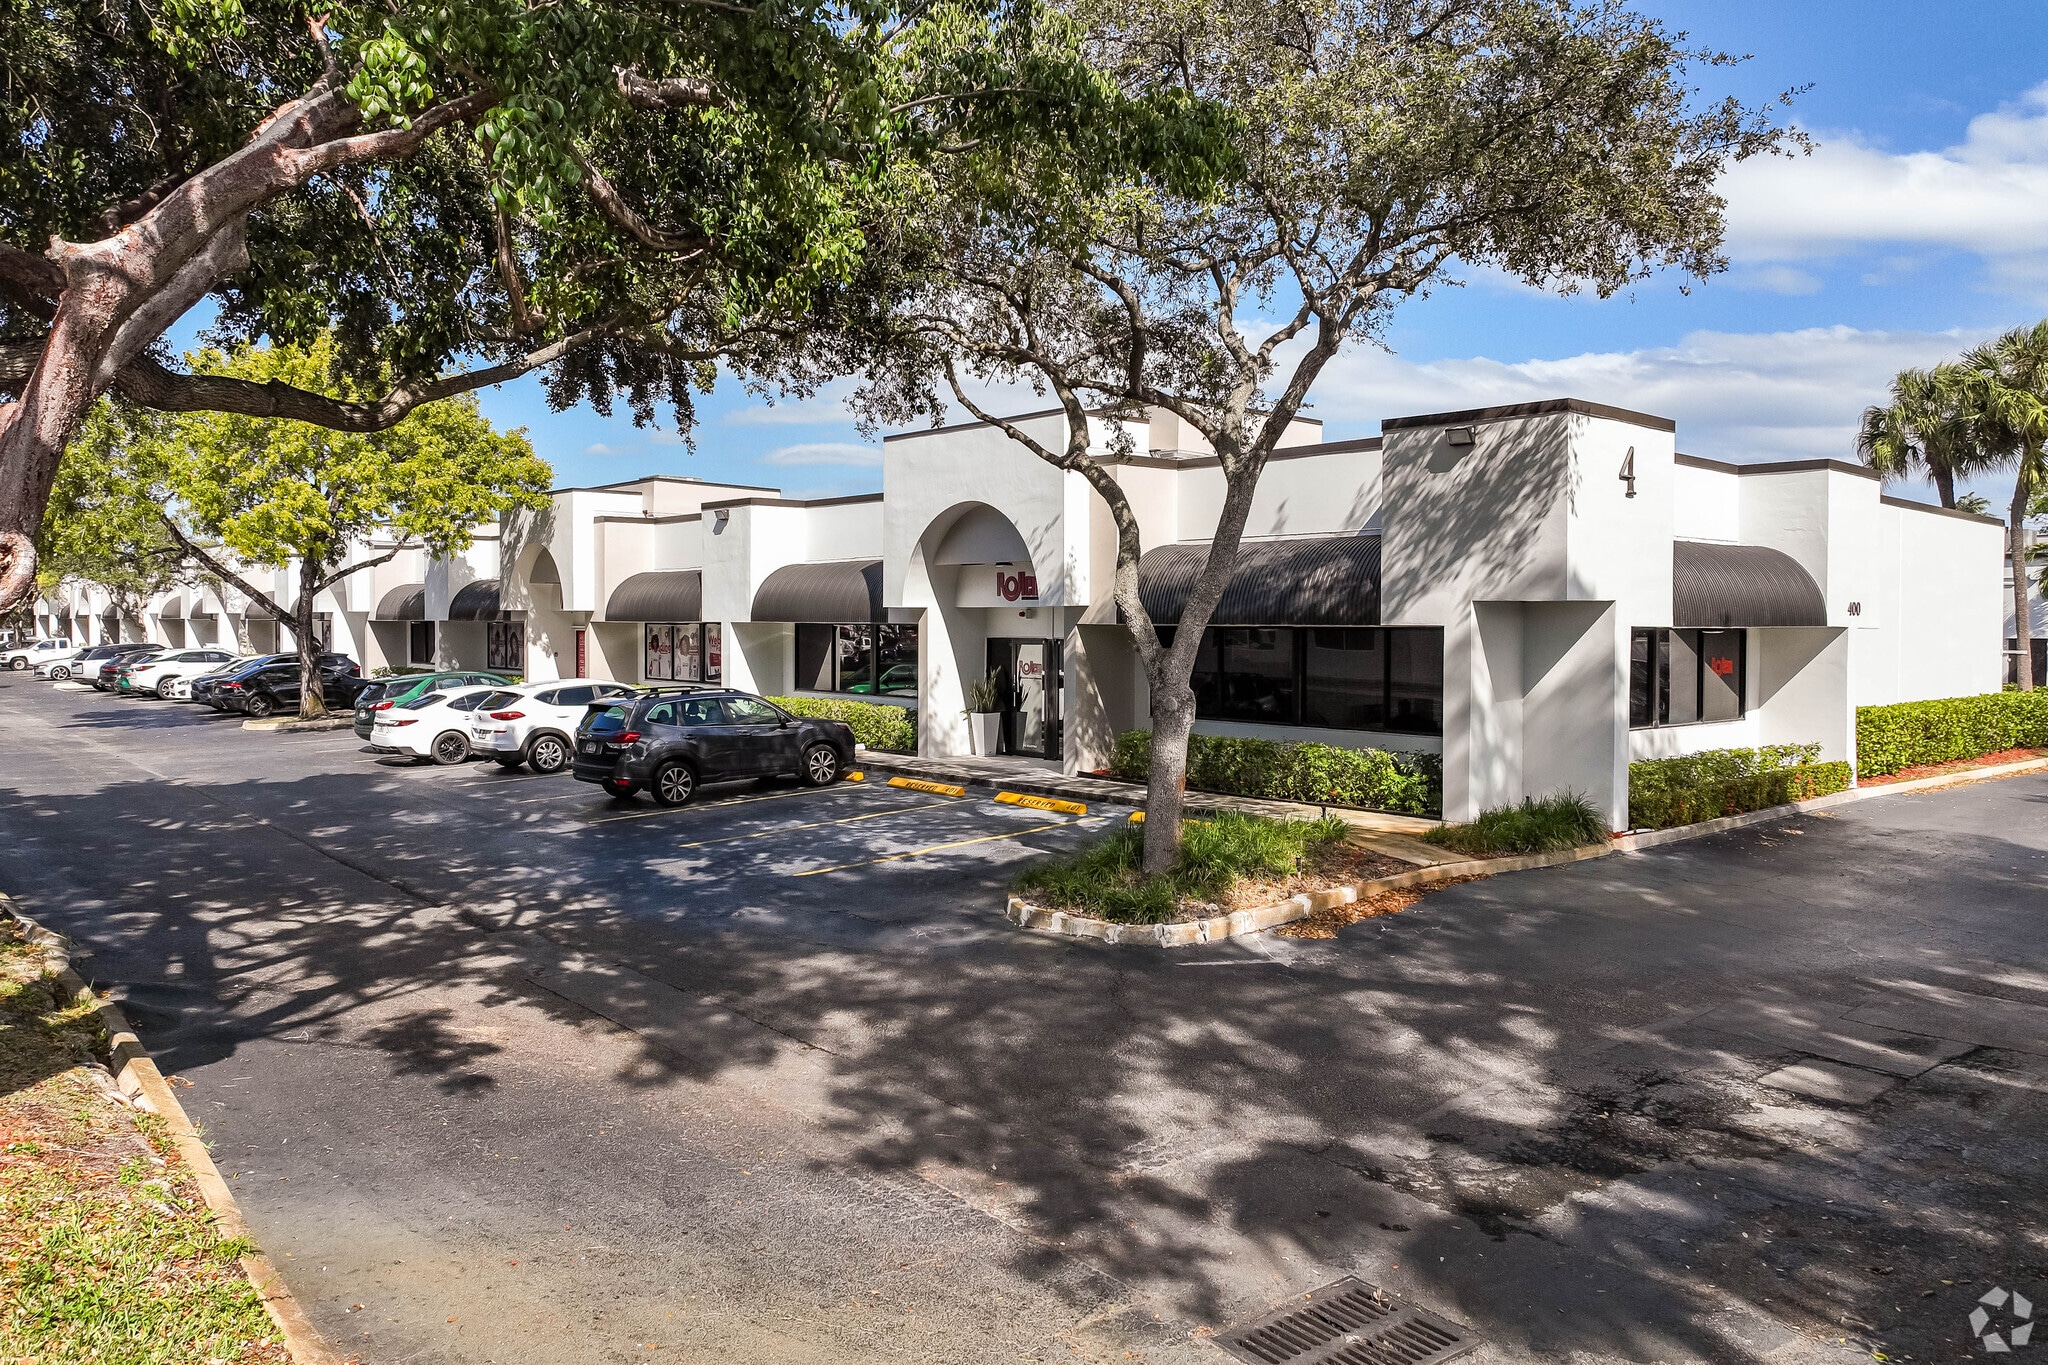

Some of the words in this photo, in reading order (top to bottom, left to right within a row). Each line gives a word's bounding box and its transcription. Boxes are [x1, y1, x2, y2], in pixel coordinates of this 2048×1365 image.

[1618, 445, 1637, 499] 4
[1847, 601, 1861, 616] 400
[1017, 797, 1056, 809] RESERVED
